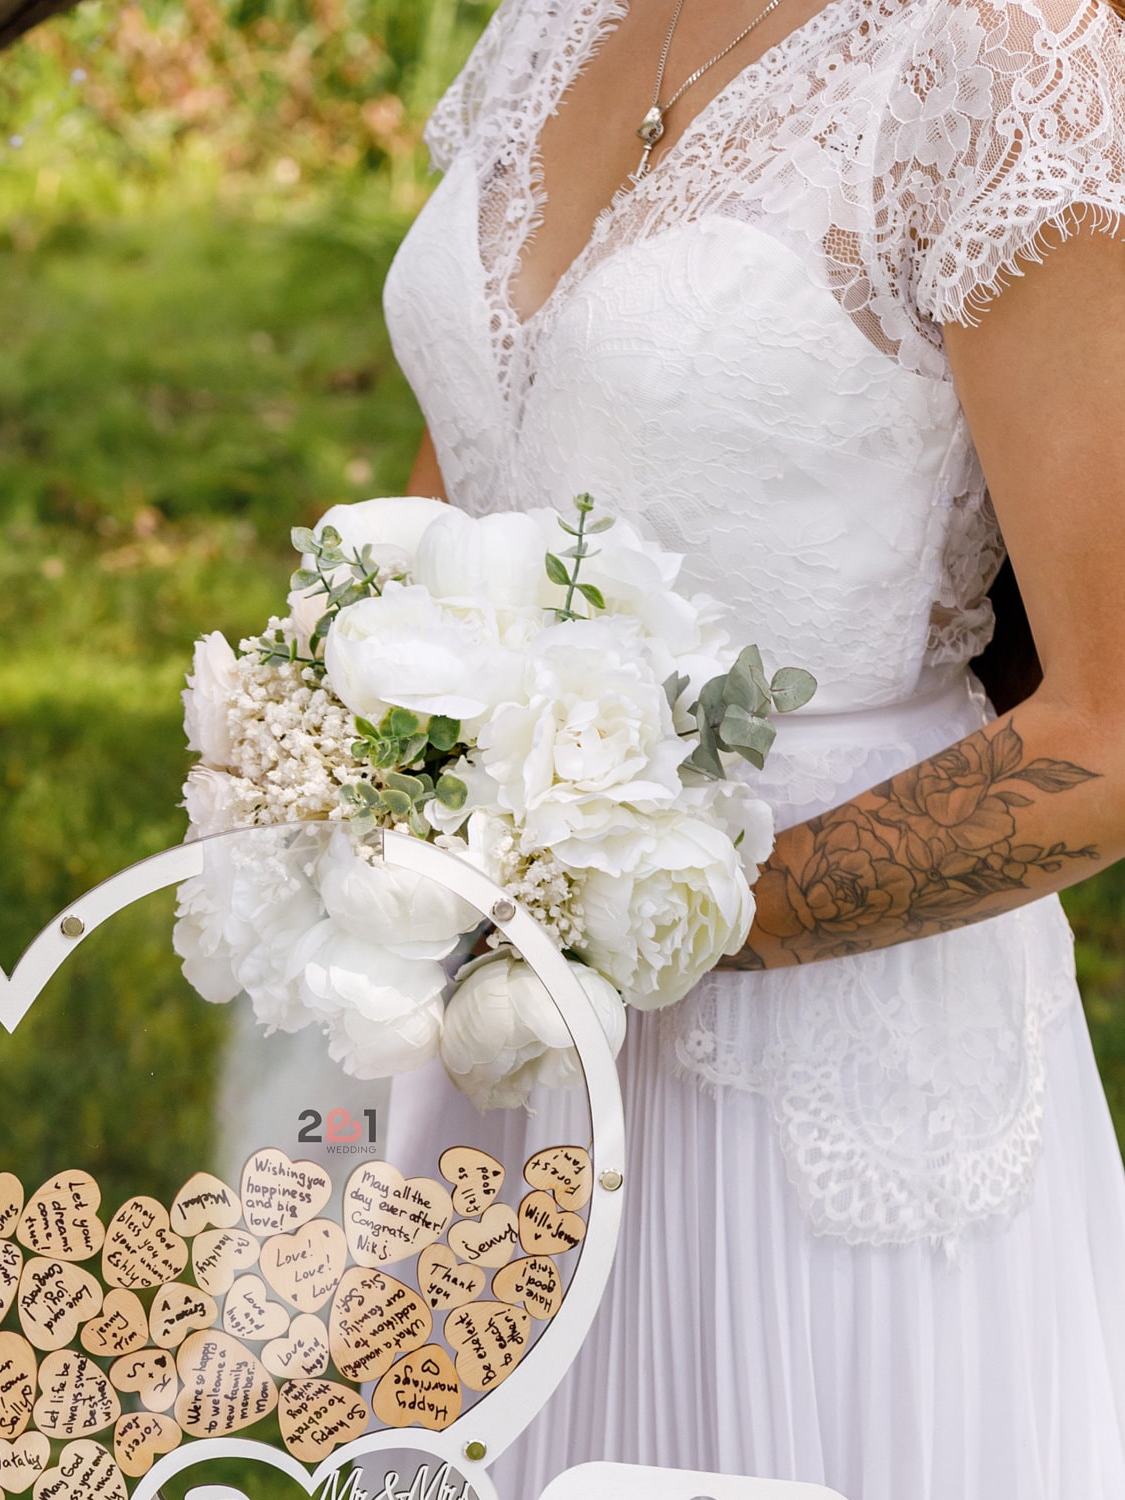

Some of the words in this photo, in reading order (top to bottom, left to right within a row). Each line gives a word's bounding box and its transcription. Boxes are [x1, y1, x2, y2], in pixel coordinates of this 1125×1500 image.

[255, 1157, 308, 1186] Wishing
[307, 1174, 326, 1190] you
[476, 1166, 496, 1196] good
[531, 1158, 581, 1196] Forest
[246, 1176, 312, 1204] happiness
[246, 1198, 272, 1209] and
[362, 1170, 389, 1198] May
[393, 1186, 410, 1200] all
[411, 1190, 432, 1209] the
[250, 1214, 285, 1231] love!
[350, 1187, 373, 1211] day
[379, 1202, 408, 1218] ever
[409, 1210, 448, 1235] after!
[351, 1210, 420, 1244] Congrats!
[276, 1239, 313, 1267] Love!
[295, 1254, 332, 1283] Love!
[429, 1262, 477, 1293] Thank
[312, 1277, 340, 1298] Love
[427, 1282, 451, 1299] you
[515, 1283, 524, 1293] a
[527, 1276, 556, 1293] good
[526, 1288, 553, 1313] Have
[277, 1339, 305, 1367] Love
[303, 1337, 320, 1359] and
[394, 1365, 458, 1394] marriage
[395, 1390, 448, 1421] Happy
